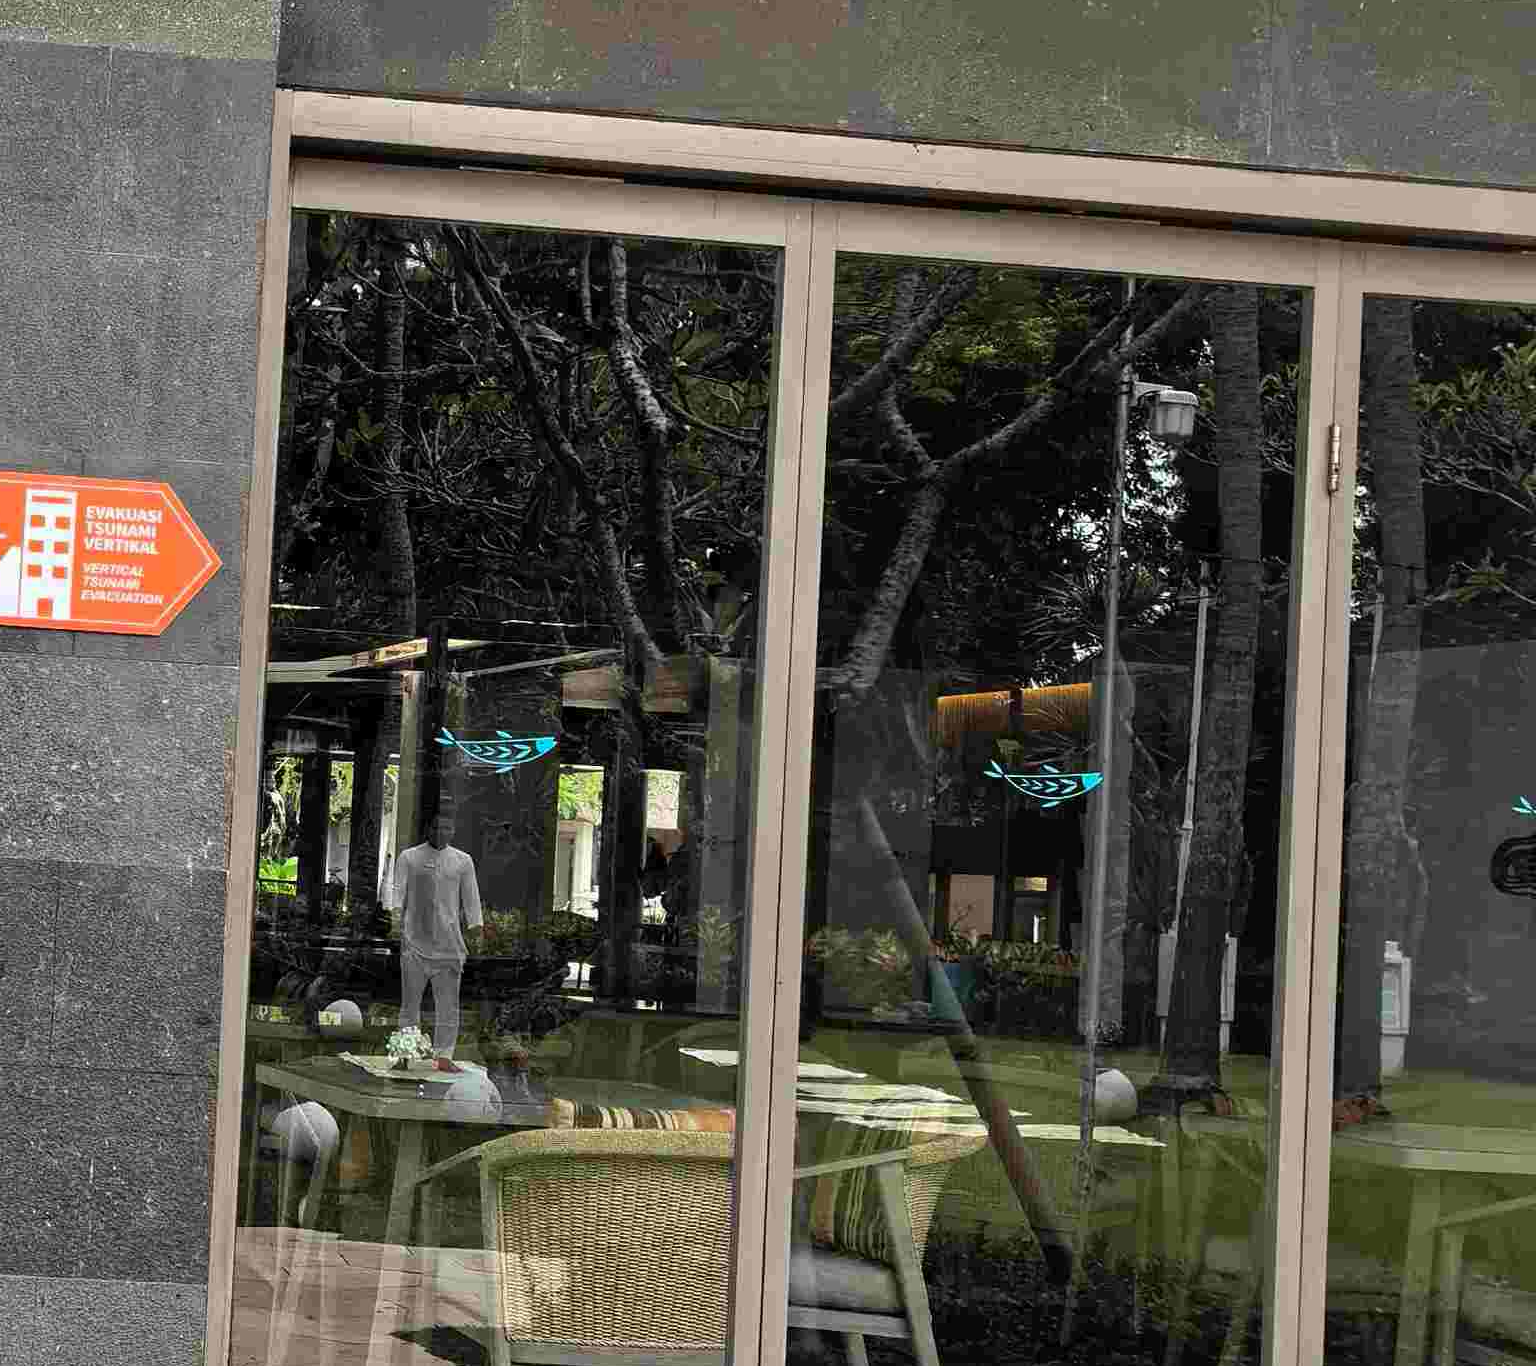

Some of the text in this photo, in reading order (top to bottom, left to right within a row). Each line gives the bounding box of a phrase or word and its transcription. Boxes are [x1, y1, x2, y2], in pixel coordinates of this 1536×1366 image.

[86, 505, 163, 523] EVAKUASI
[85, 522, 156, 539] TSUNAMI
[84, 538, 160, 555] VERTIKAL
[82, 563, 145, 577] VERTICAL
[81, 576, 140, 590] TSUNAMI
[80, 590, 163, 604] EVACUATION
